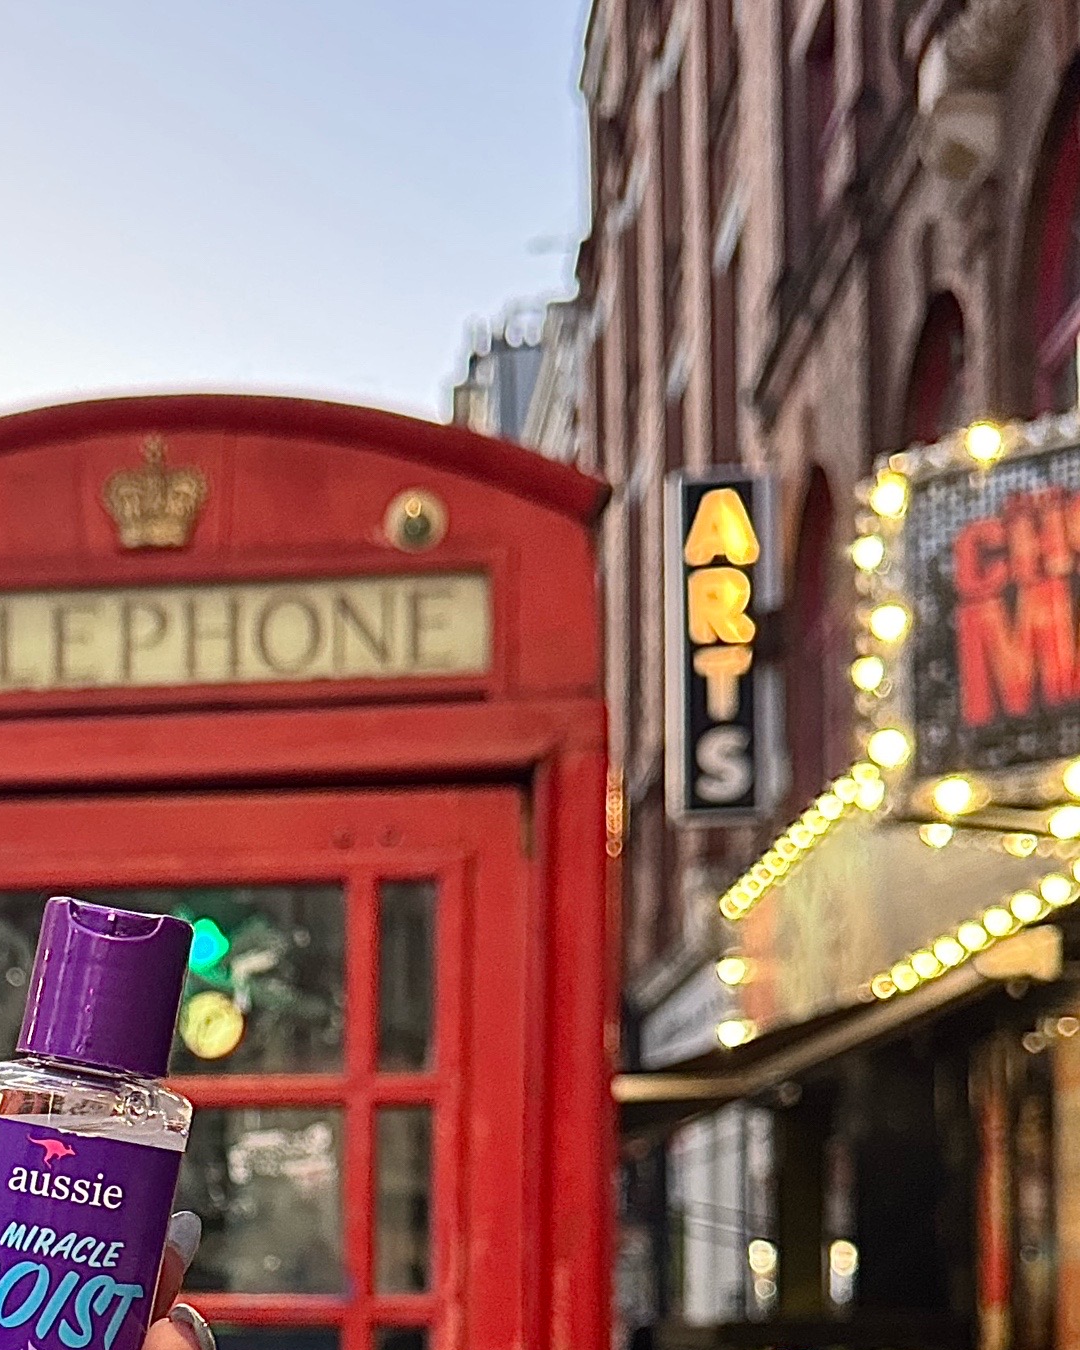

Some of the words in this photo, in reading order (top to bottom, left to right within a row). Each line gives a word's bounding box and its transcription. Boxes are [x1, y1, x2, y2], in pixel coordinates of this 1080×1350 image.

[685, 488, 760, 801] ARTS
[8, 1166, 123, 1209] aussie
[0, 1221, 124, 1268] MIRACLE
